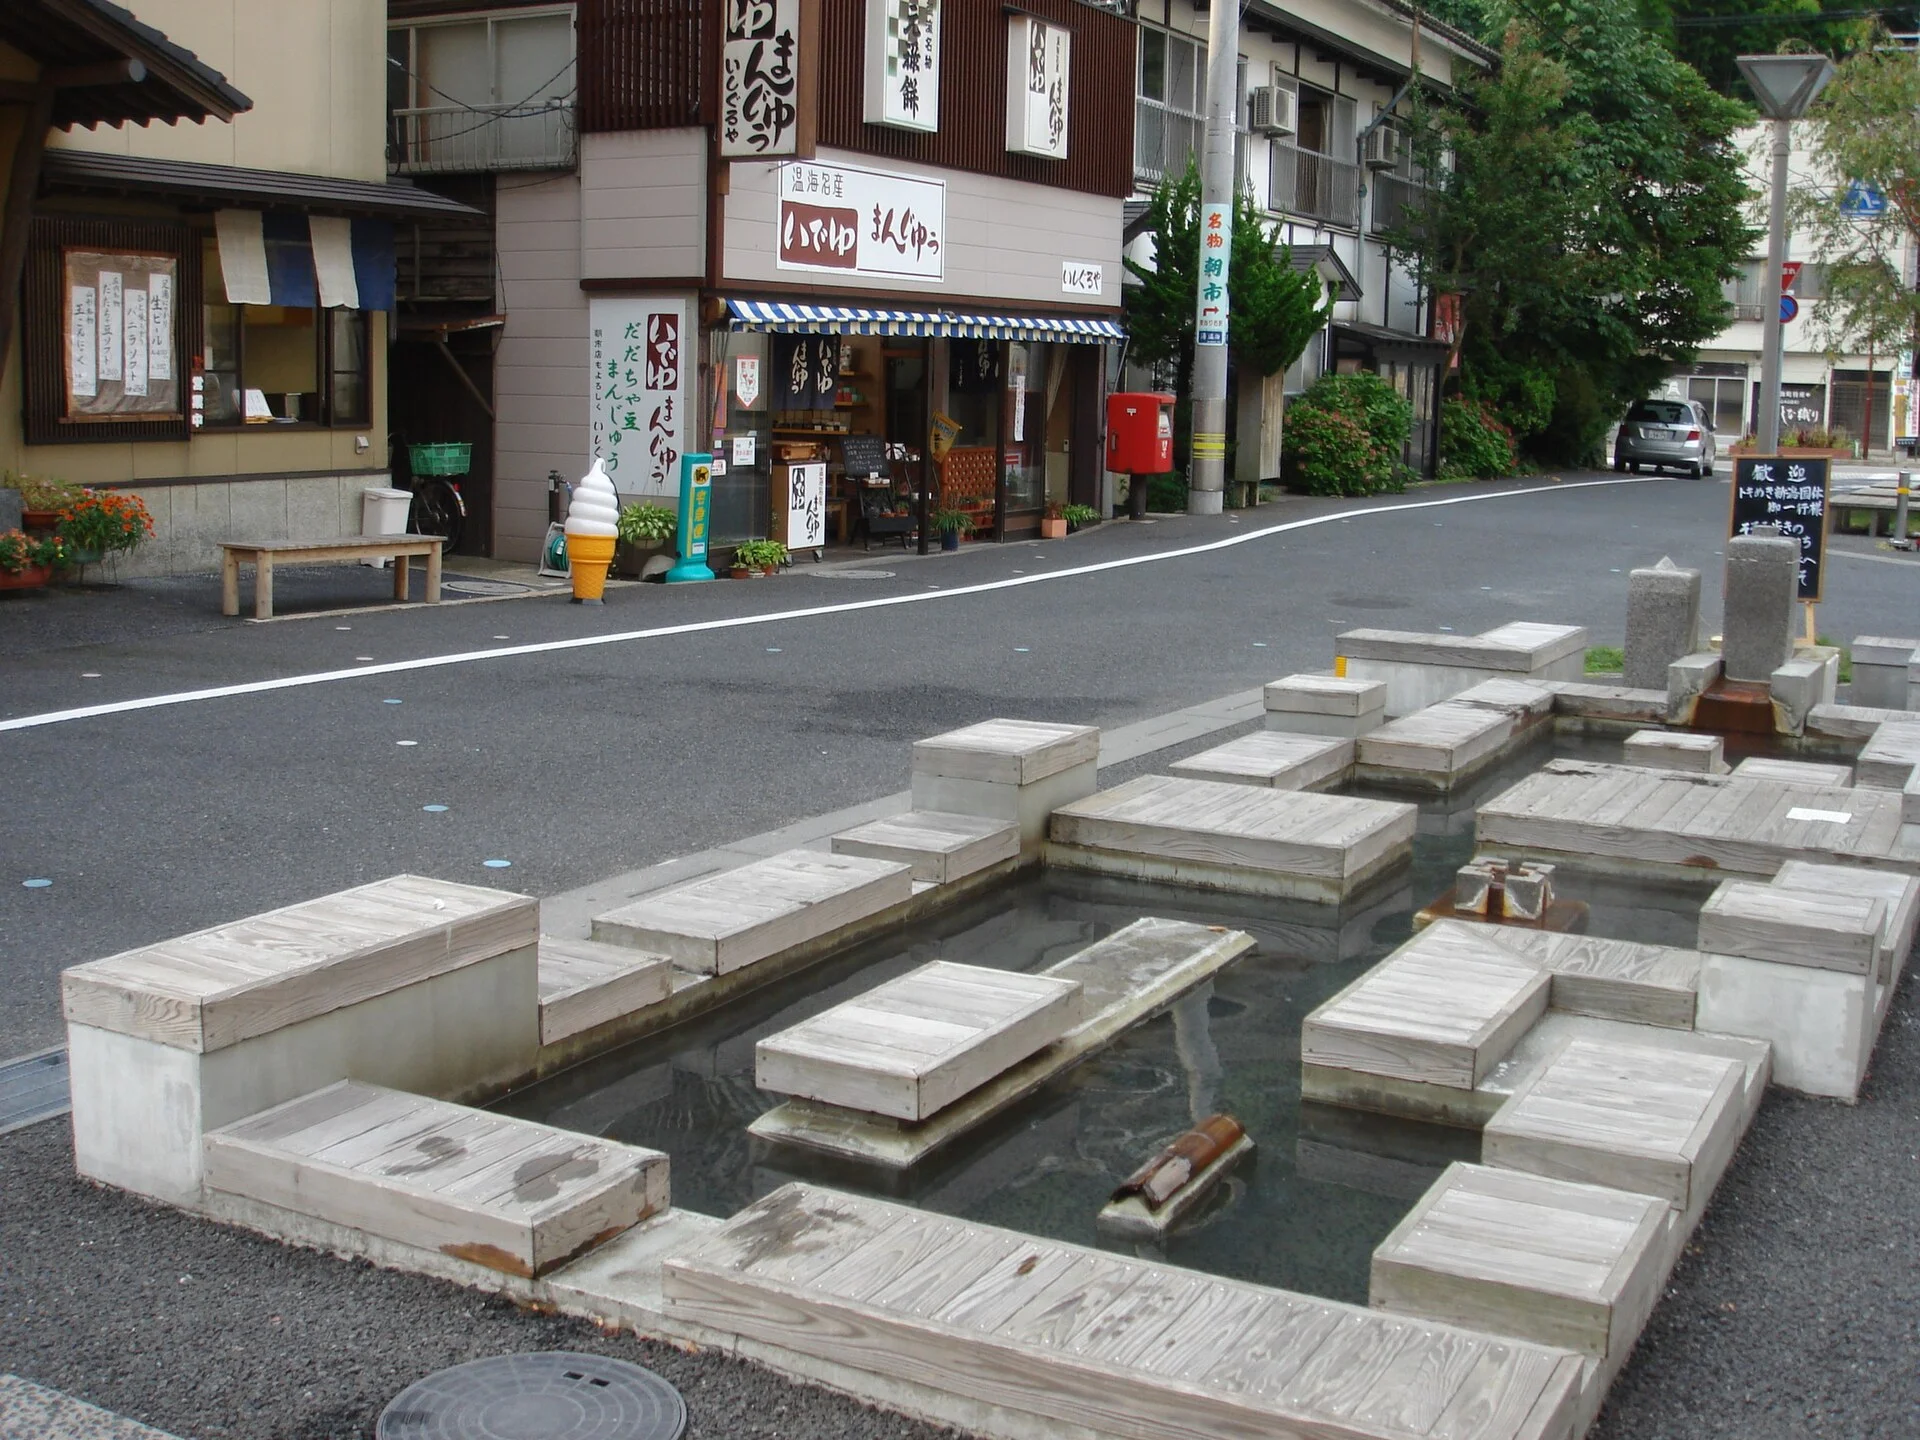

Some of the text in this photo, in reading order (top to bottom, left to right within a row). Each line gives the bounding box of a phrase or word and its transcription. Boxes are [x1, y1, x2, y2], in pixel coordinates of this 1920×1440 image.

[729, 0, 773, 39] ゆ
[1031, 22, 1045, 92] いでゆ
[742, 28, 796, 153] まんじゅう
[1049, 77, 1064, 151] まんじゅう
[791, 166, 844, 199] 温海名産
[783, 210, 857, 257] いでゆ
[871, 202, 940, 263] まんじゅう
[1206, 211, 1224, 249] 名物
[1062, 269, 1101, 291] いしぐろや
[1202, 256, 1223, 302] 朝市
[127, 306, 138, 381] バニラソフト
[151, 295, 162, 346] 生ビール
[621, 322, 642, 432] だだちゃ豆
[647, 314, 678, 391] いでゆ
[791, 339, 808, 395] まんじゅう
[817, 339, 833, 394] いでゆ
[593, 329, 604, 460] 朝市店もよろしく いしぐ
[604, 358, 623, 472] まんじゅう
[649, 395, 677, 484] まんじゅう
[793, 468, 805, 510] いでゆ
[1751, 463, 1807, 483] 歓迎
[806, 494, 820, 544] まんじゅう
[1767, 501, 1823, 517] 御一行様
